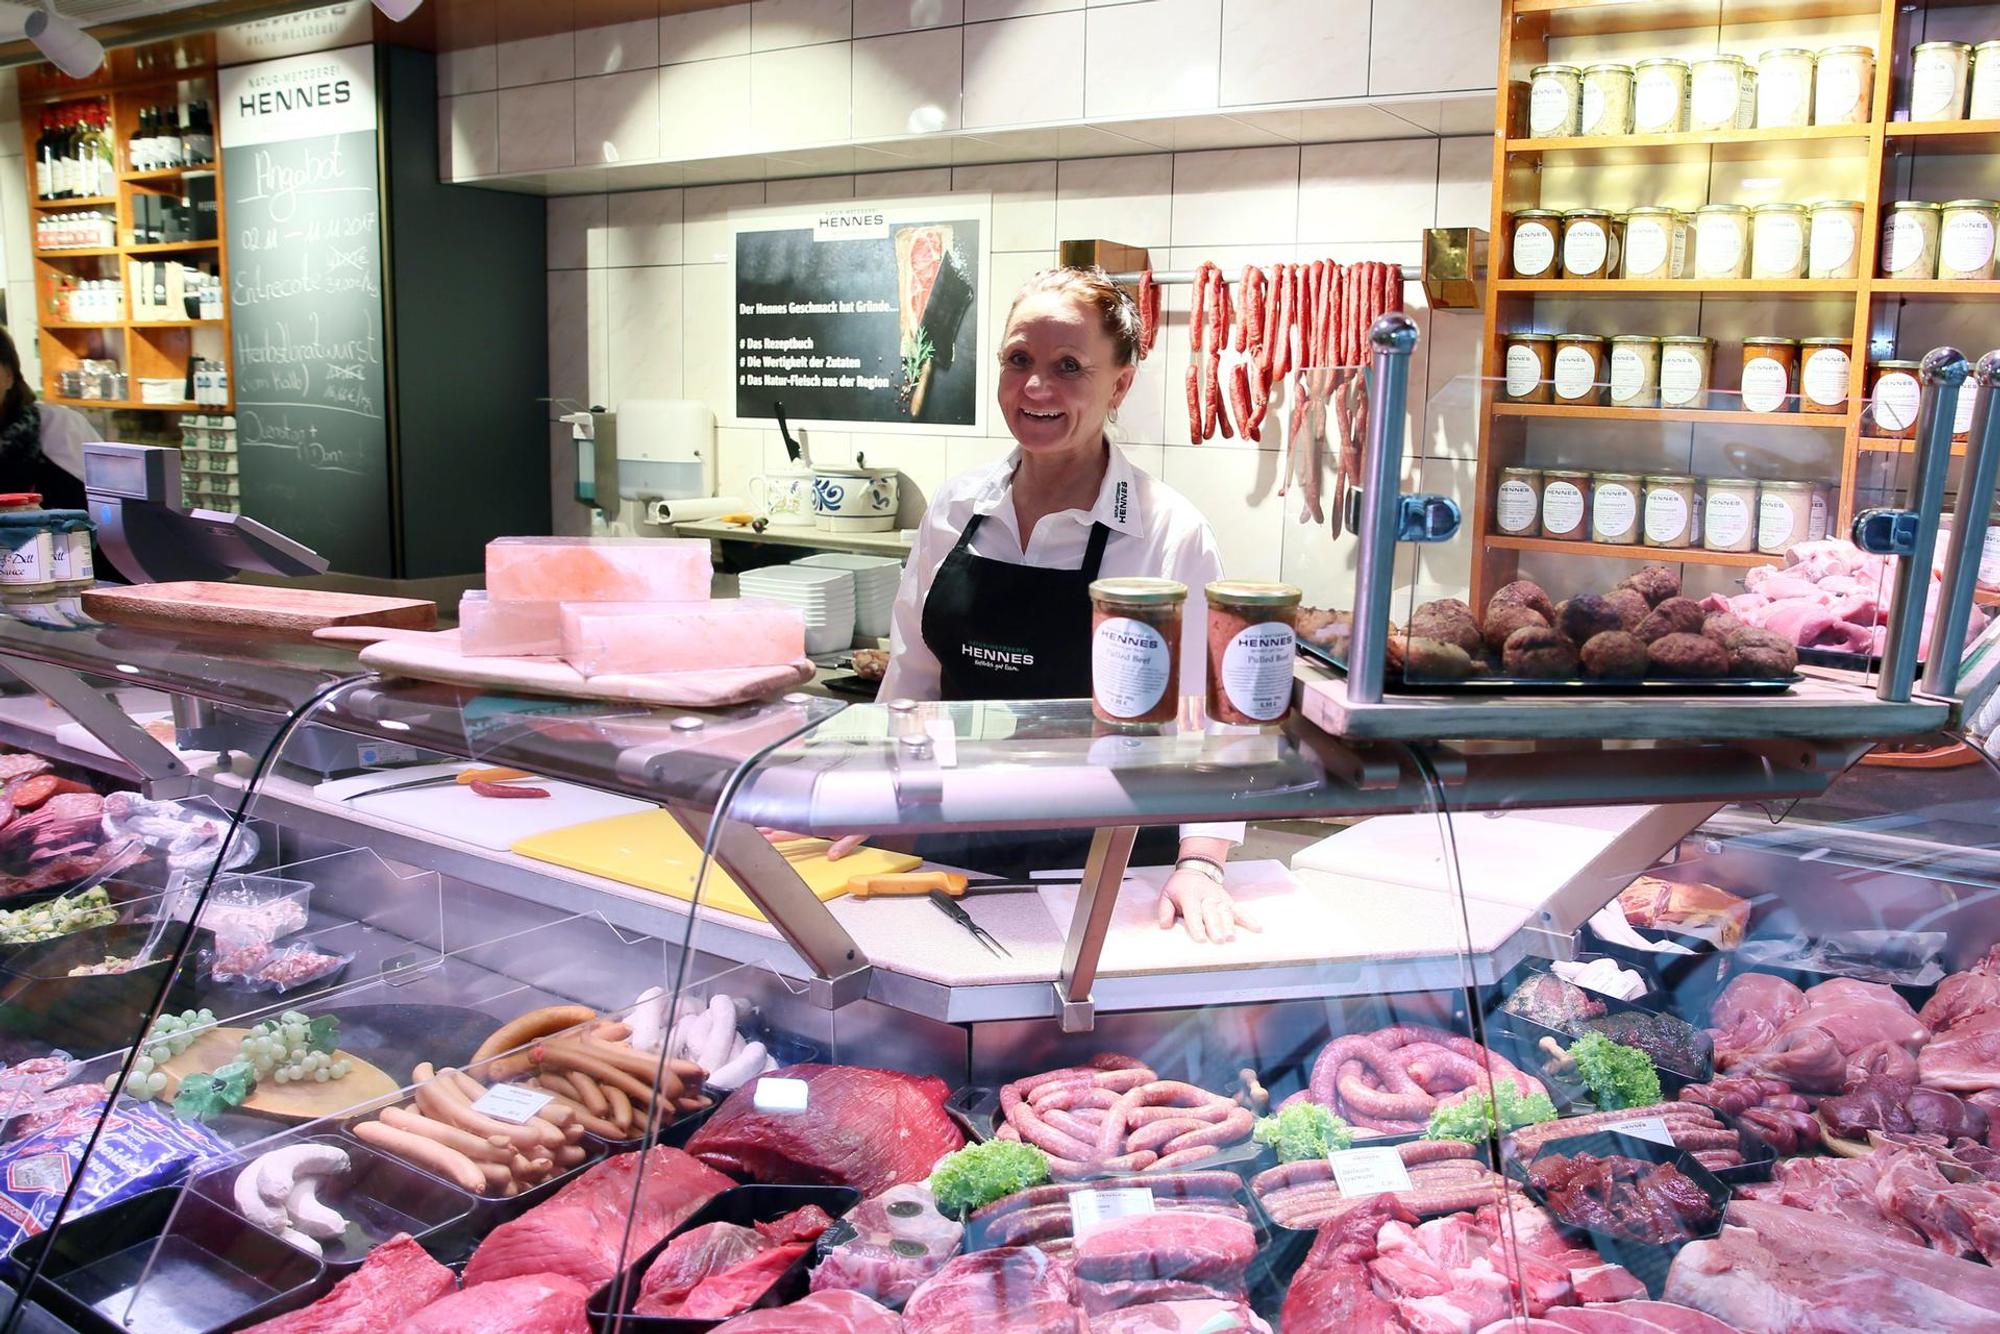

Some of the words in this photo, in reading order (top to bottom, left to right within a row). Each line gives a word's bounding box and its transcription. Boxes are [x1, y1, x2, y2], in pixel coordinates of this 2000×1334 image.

[239, 80, 351, 117] HENNES
[819, 214, 884, 228] HENNES
[739, 303, 754, 315] Der
[756, 302, 787, 315] Hennes
[788, 301, 838, 314] Geschmack
[839, 301, 854, 313] hat
[740, 338, 745, 350] #
[747, 338, 763, 350] Das
[763, 337, 814, 352] Rezeptbuch
[740, 357, 745, 367] #
[747, 356, 762, 368] Die
[763, 355, 808, 370] Wertigkeit
[808, 355, 824, 368] der
[825, 356, 861, 368] Zutaten
[740, 374, 745, 385] #
[747, 374, 763, 386] Das
[763, 374, 821, 387] Natur-Fleisch
[822, 376, 838, 387] aus
[839, 375, 855, 387] der
[856, 375, 889, 390] Region
[1118, 481, 1127, 524] HENNES
[1101, 630, 1158, 649] HENNES
[1239, 635, 1293, 647] HENNES
[962, 643, 1034, 665] HENNES
